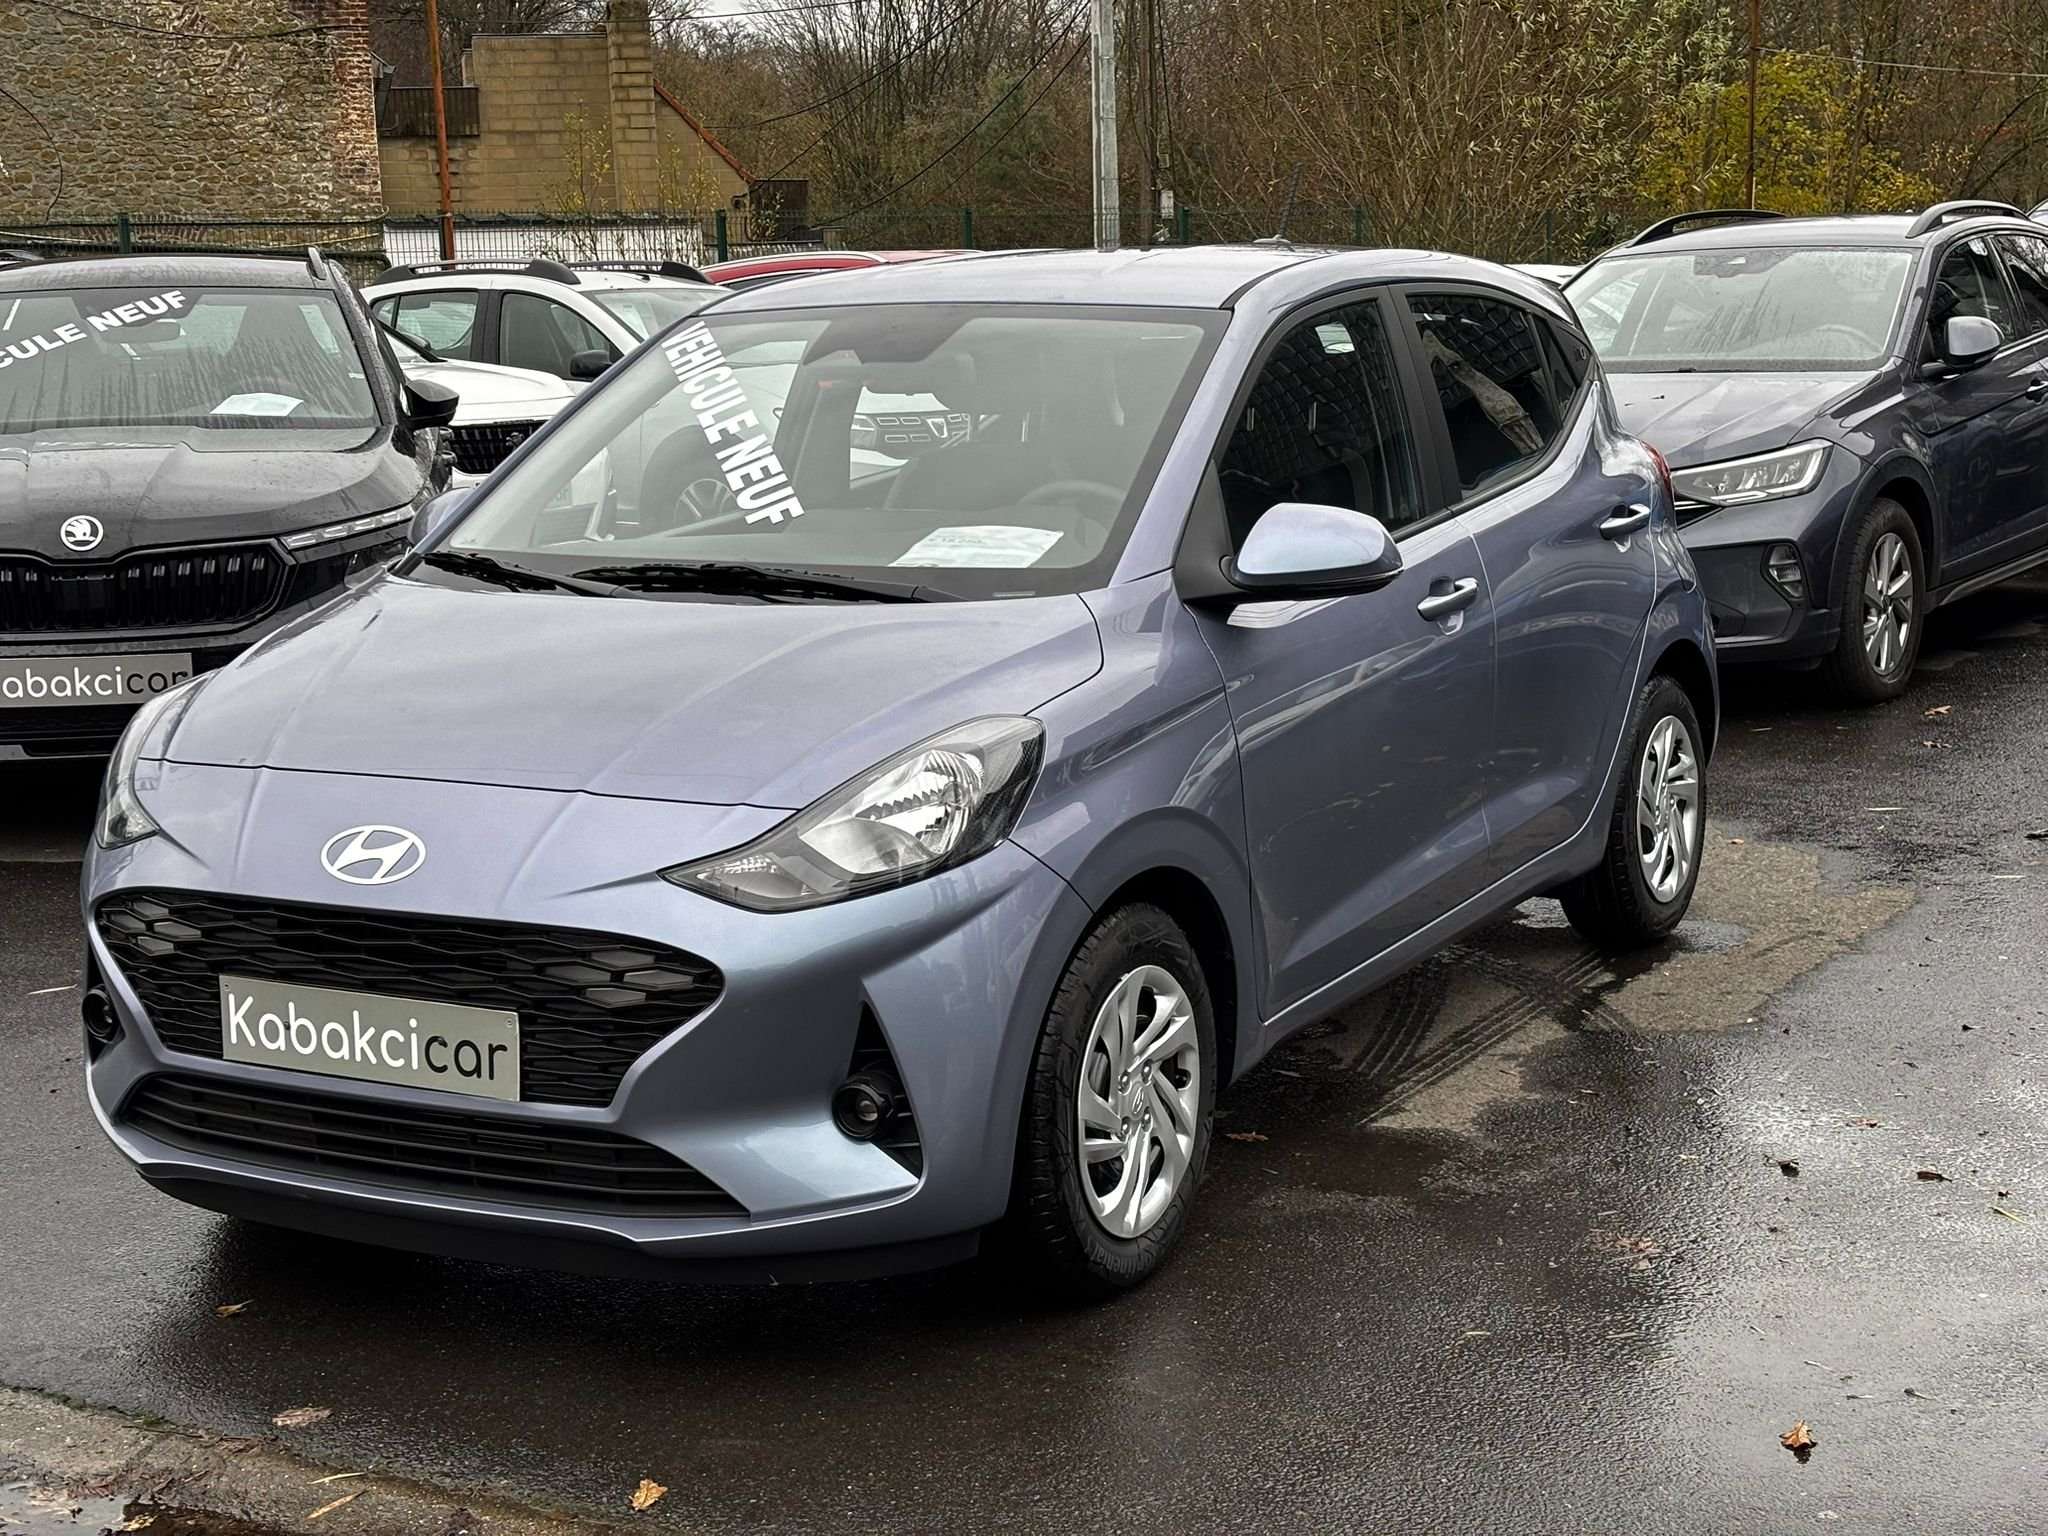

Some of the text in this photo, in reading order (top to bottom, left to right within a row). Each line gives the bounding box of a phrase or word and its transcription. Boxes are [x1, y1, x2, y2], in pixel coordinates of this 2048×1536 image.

[86, 290, 187, 332] NEUF
[660, 320, 805, 524] VEHICULE NEUF
[0, 665, 188, 698] abakcicar
[228, 993, 508, 1080] Kabakcicar
[1090, 1242, 1155, 1278] ontinental
